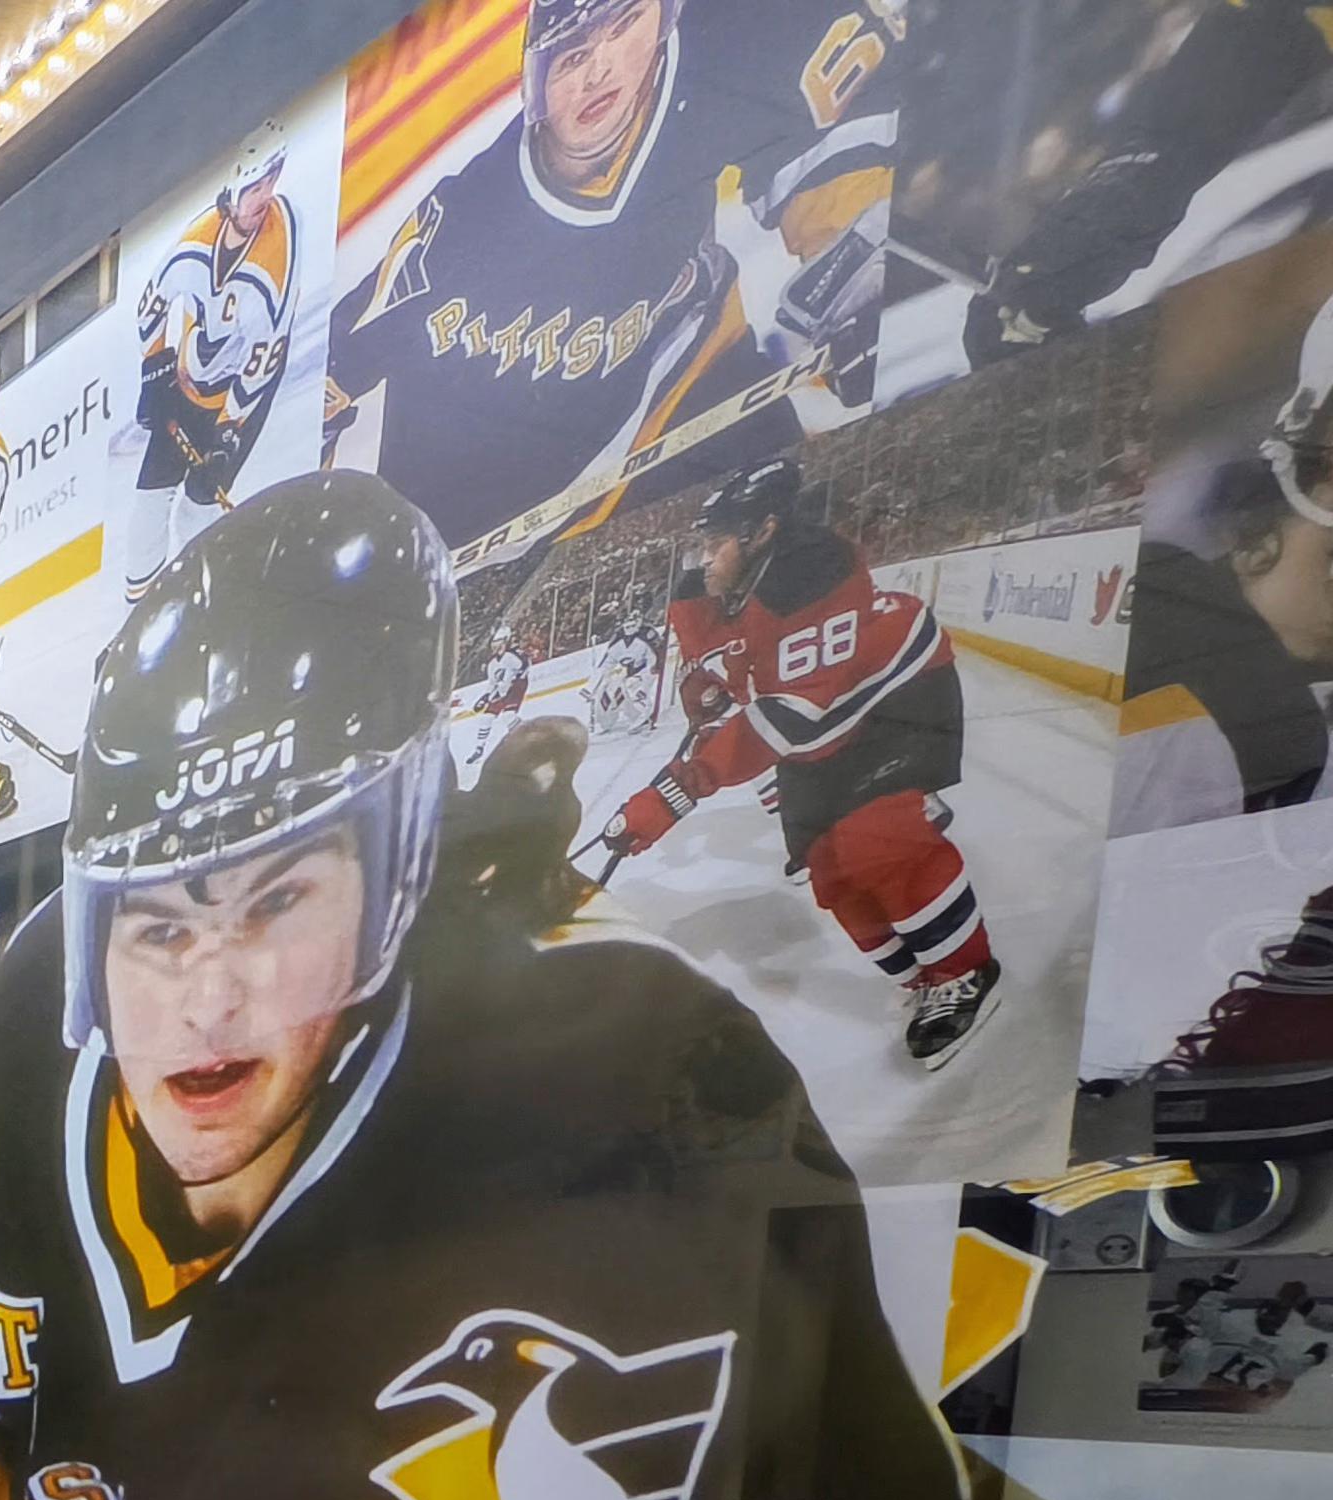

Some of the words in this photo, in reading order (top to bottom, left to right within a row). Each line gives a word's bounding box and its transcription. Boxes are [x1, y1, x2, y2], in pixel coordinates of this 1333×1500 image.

[221, 292, 237, 322] C
[15, 475, 77, 533] Invest
[778, 610, 859, 682] 68
